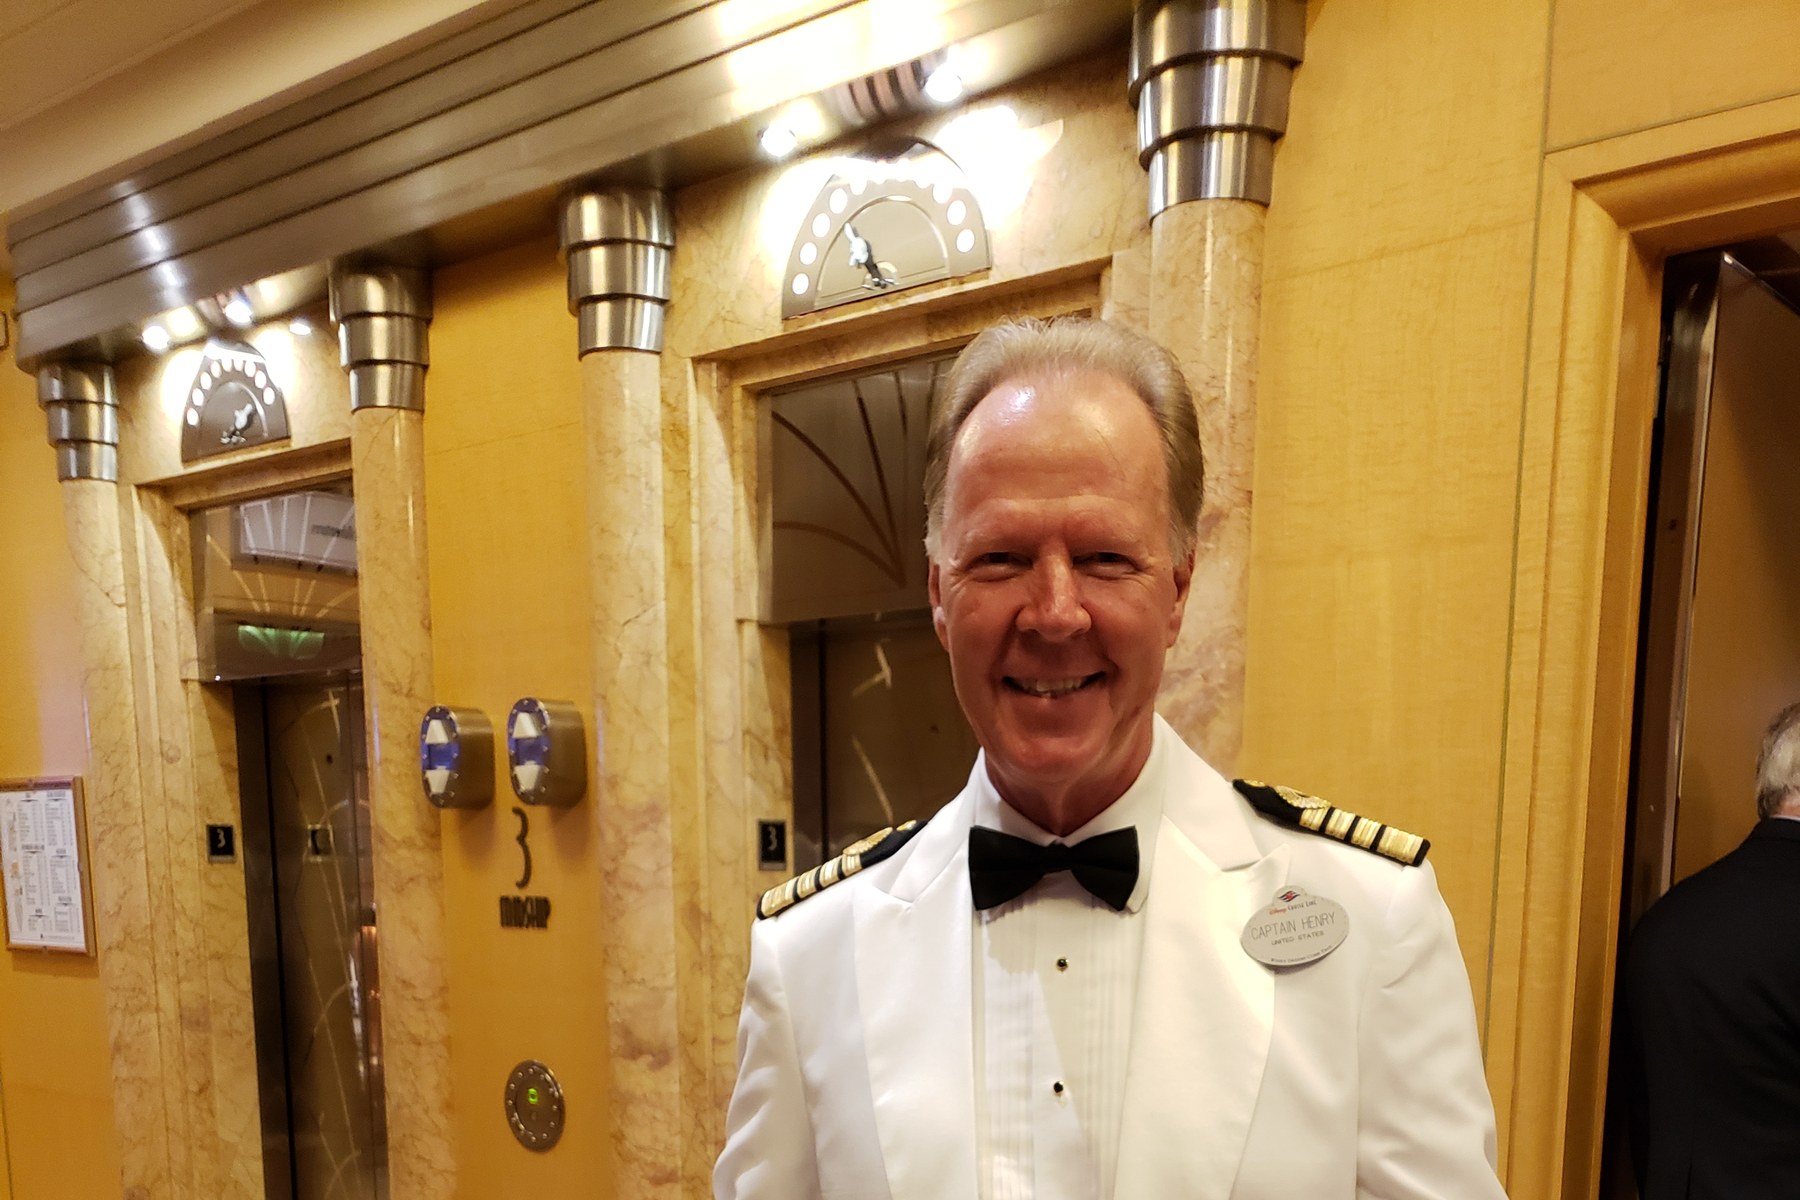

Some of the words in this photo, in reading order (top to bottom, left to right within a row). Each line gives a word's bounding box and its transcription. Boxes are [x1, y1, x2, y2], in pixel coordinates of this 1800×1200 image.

[216, 828, 227, 849] 3
[1250, 920, 1297, 940] CAPTAIN
[1301, 912, 1335, 930] HENRY
[1271, 936, 1295, 946] UNITED
[1298, 930, 1325, 941] STATES
